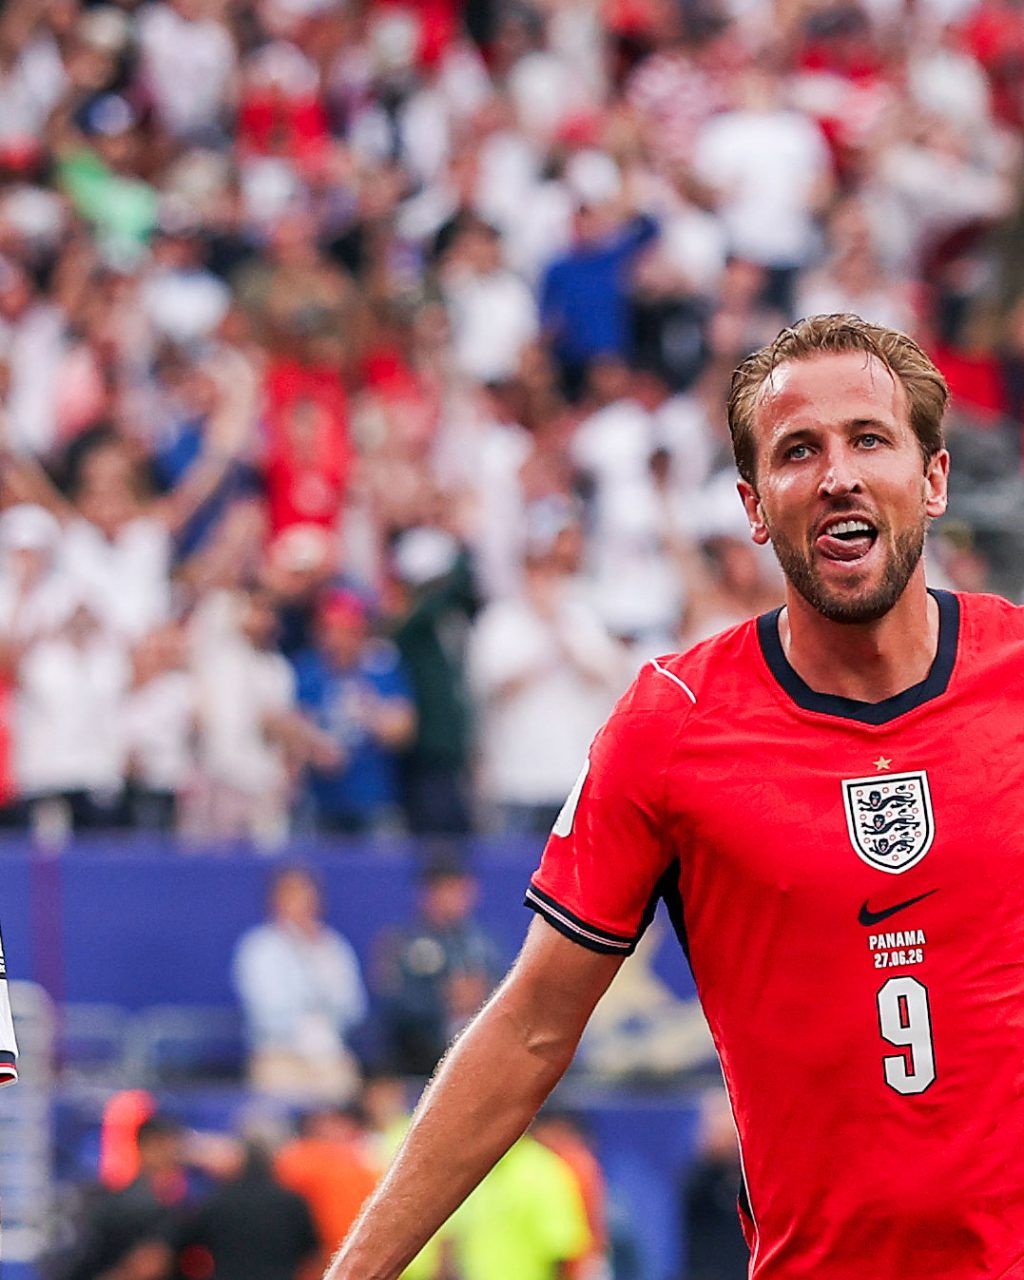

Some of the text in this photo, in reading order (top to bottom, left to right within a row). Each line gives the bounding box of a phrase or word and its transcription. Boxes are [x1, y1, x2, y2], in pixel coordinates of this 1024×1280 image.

[869, 929, 926, 950] PANAMA
[874, 948, 924, 968] 27.06.26
[877, 976, 937, 1095] 9
